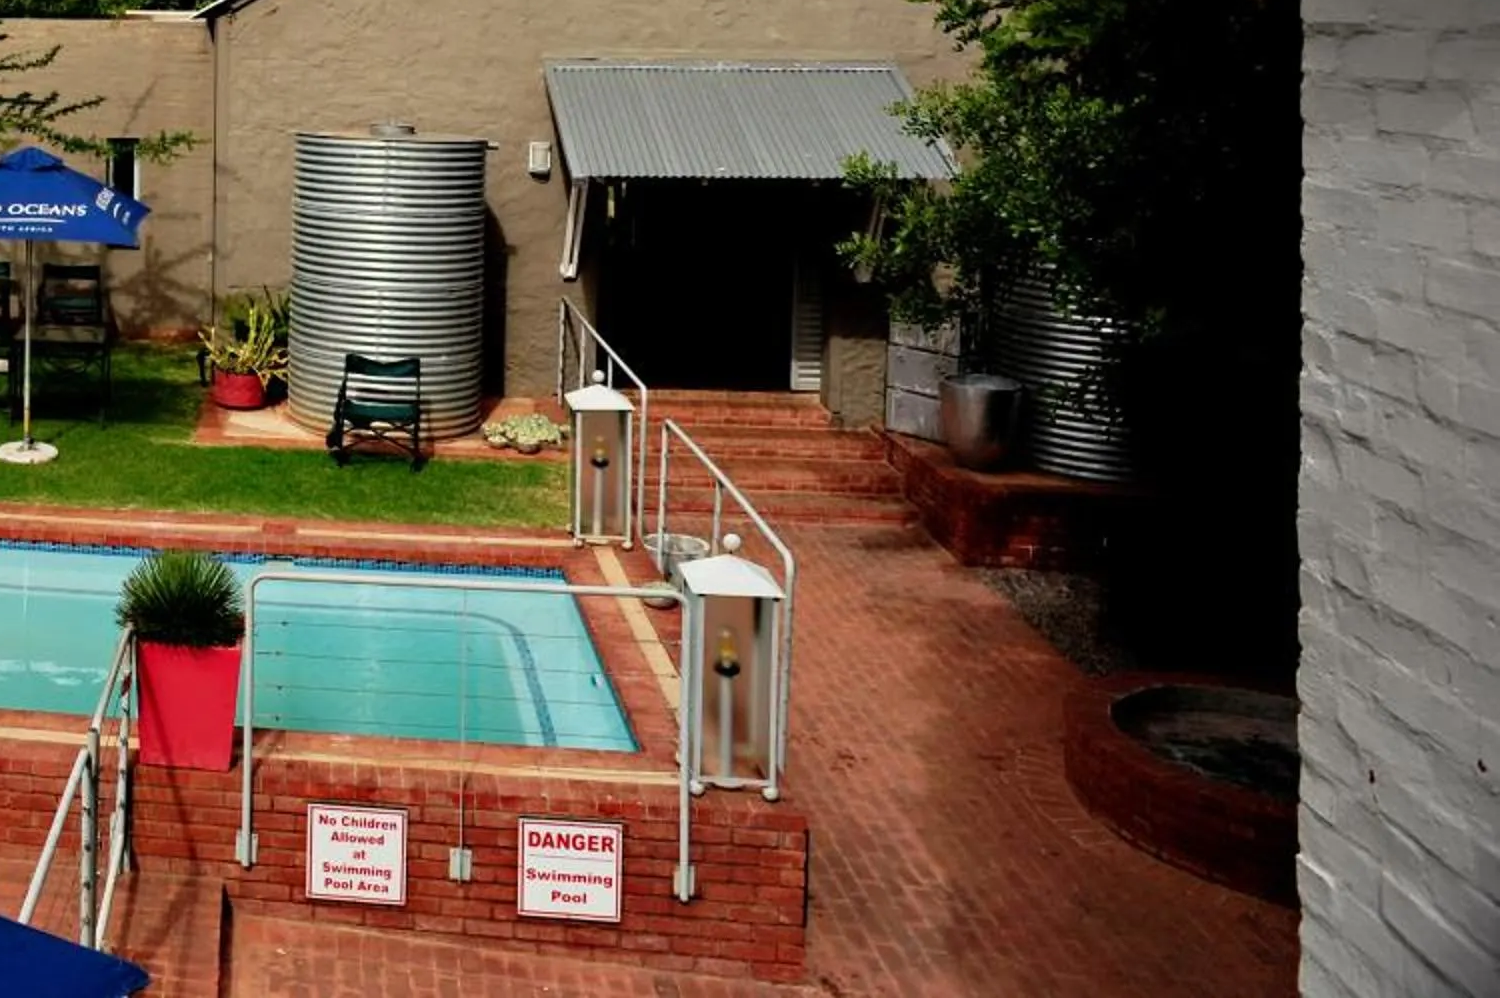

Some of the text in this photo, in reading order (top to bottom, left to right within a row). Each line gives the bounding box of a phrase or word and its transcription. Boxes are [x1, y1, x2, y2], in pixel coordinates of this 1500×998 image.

[7, 203, 88, 216] OCEANS
[319, 814, 397, 830] No Children
[331, 831, 385, 845] Allowed
[528, 831, 614, 852] DANGER
[353, 850, 366, 860] at
[323, 862, 392, 880] Swimming
[526, 868, 613, 888] Swimming
[324, 878, 389, 893] Pool Area
[551, 890, 587, 904] Pool
